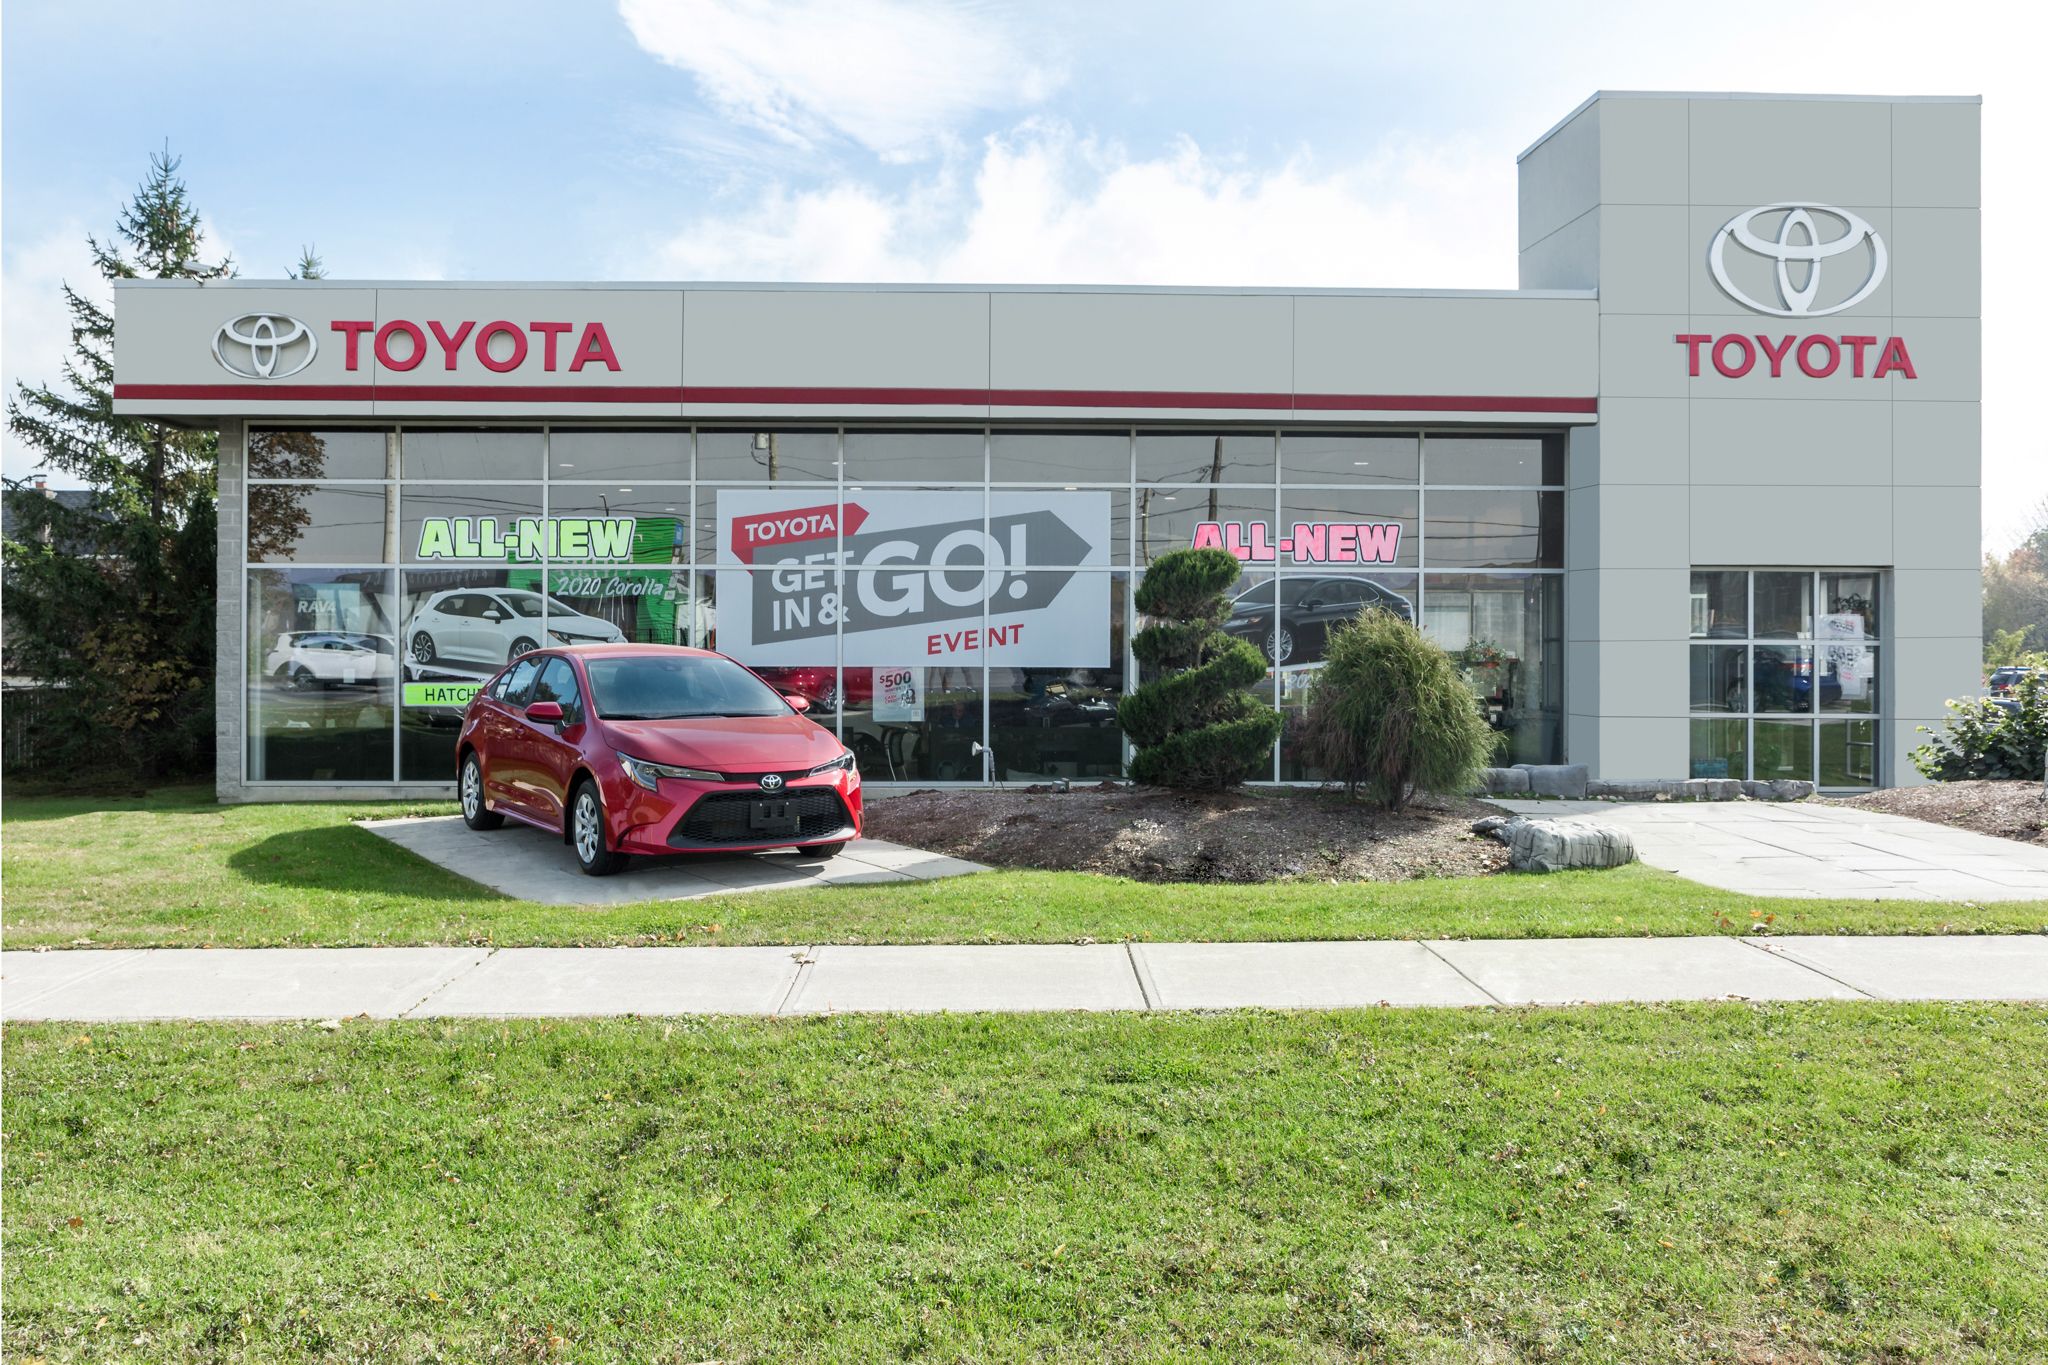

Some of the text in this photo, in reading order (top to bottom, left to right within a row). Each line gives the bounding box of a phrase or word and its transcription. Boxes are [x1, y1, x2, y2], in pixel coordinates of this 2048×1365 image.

[331, 320, 622, 373] TOYOTA
[1675, 334, 1918, 380] TOYOTA
[416, 516, 636, 560] ALL-NEW
[745, 513, 836, 541] TOYOTA
[1193, 522, 1402, 563] ALL-NEW
[556, 576, 664, 596] 2020 Corolla
[771, 550, 855, 593] GET
[857, 523, 1028, 617] GO!
[773, 592, 851, 631] IN &
[927, 623, 1025, 656] EVENT
[424, 688, 482, 701] HATCH
[879, 670, 912, 688] $500
